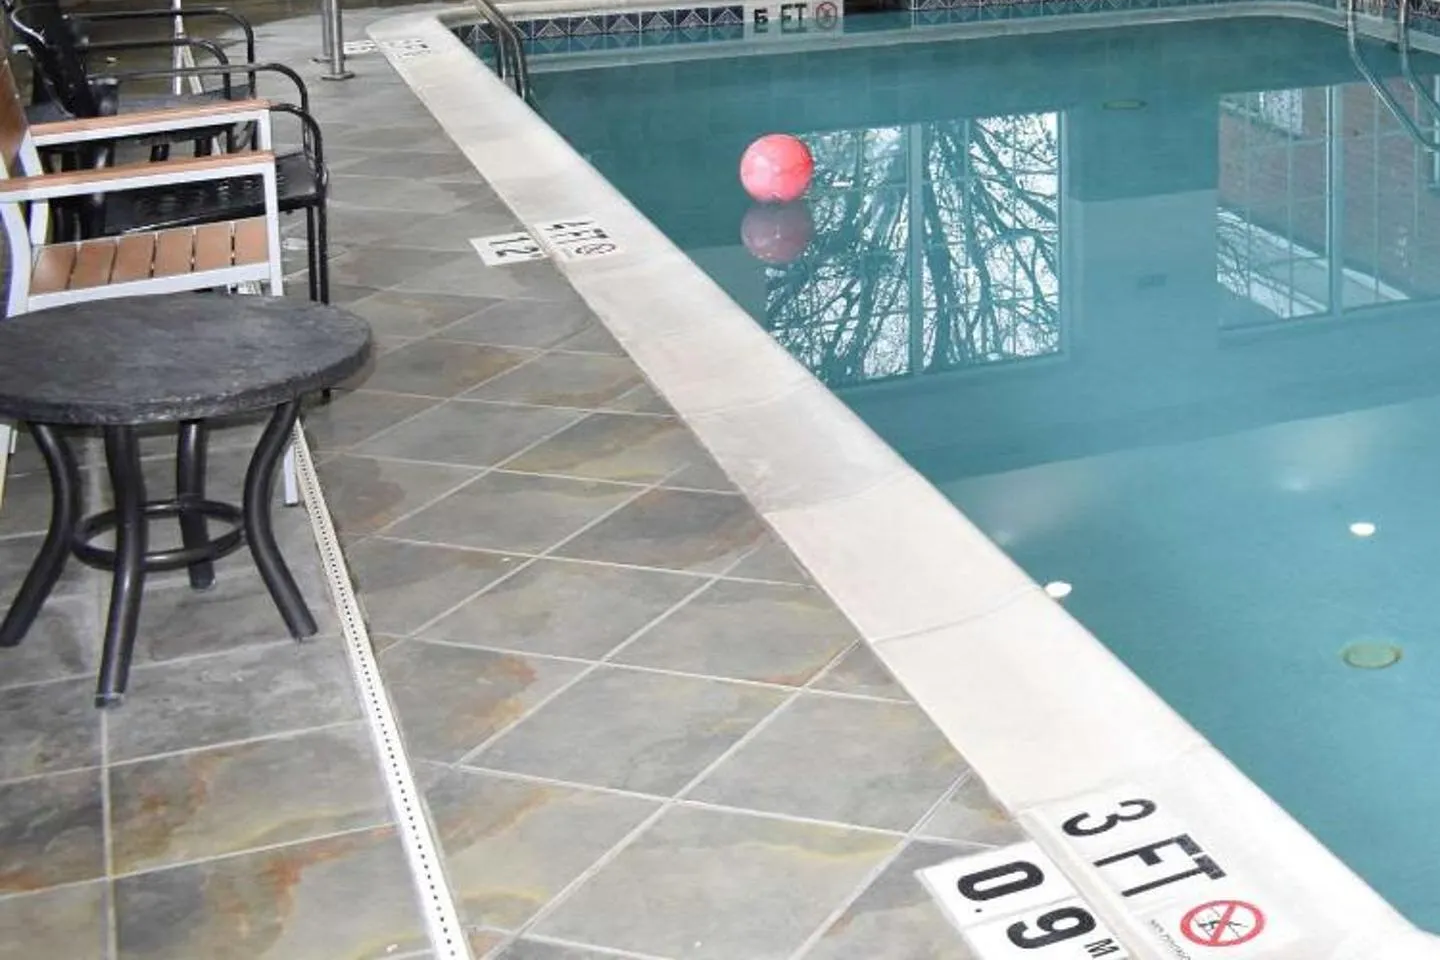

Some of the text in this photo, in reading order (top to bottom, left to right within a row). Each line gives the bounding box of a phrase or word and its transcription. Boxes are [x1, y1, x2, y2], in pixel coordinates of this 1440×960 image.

[1061, 798, 1227, 899] 3 FT
[957, 860, 1097, 950] 0.9
